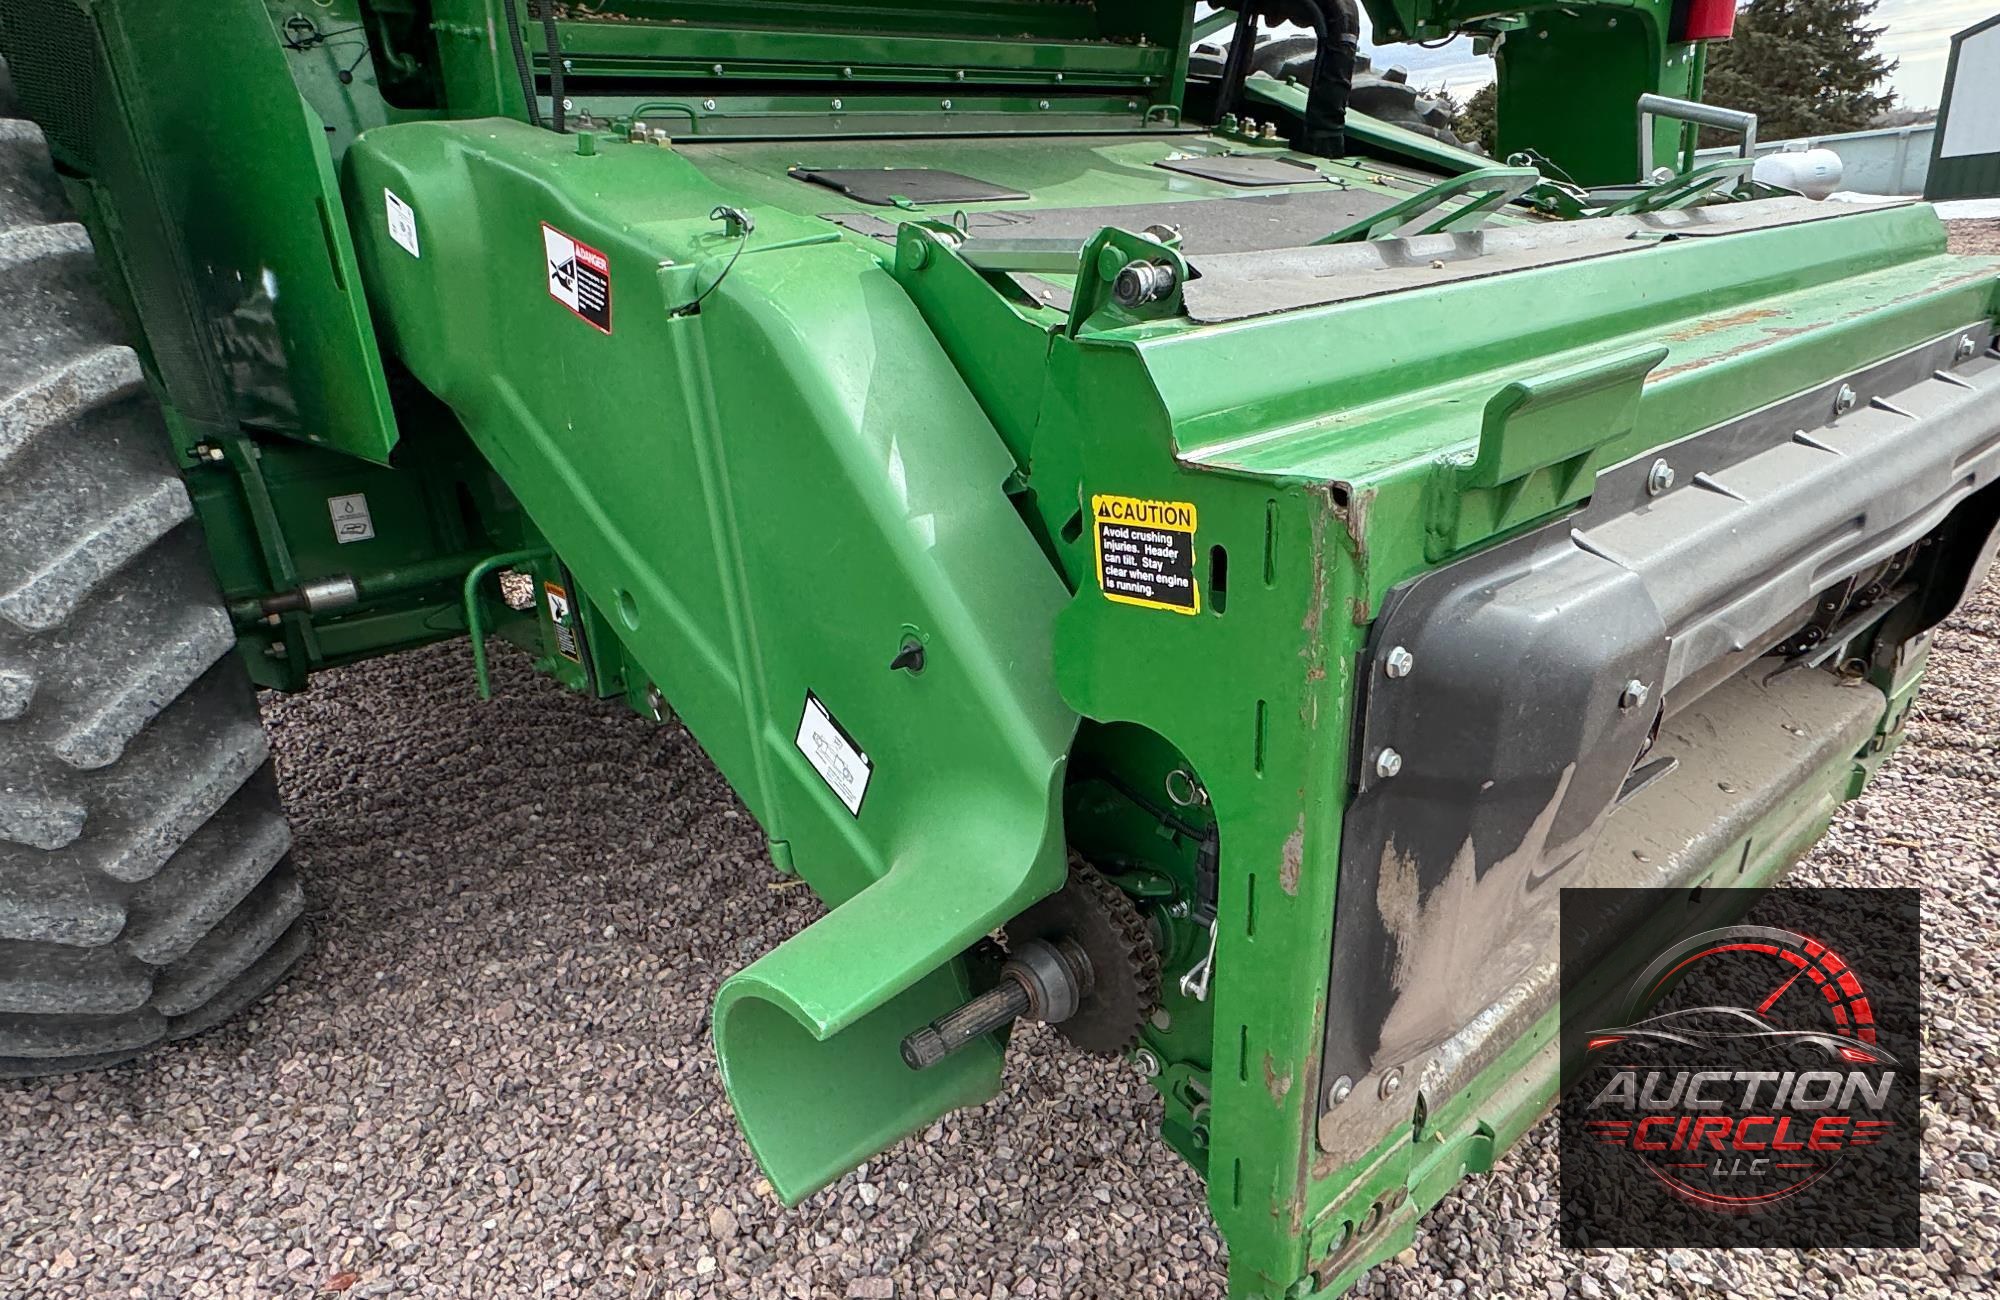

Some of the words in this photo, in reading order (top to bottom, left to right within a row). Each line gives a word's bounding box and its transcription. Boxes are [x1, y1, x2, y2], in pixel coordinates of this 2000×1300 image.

[580, 247, 608, 272] DANGER
[1111, 501, 1191, 527] CAUTION
[1103, 525, 1129, 540] Avoid
[1131, 530, 1173, 547] crushing
[1103, 539, 1140, 554] injuries.
[1144, 543, 1179, 559] Header
[1104, 554, 1121, 564] can
[1122, 554, 1138, 566] tilt.
[1141, 556, 1164, 572] Stay
[1105, 564, 1127, 578] clear
[1128, 567, 1155, 583] when
[1155, 574, 1189, 588] engine
[1106, 577, 1115, 588] is
[1116, 580, 1155, 597] running.
